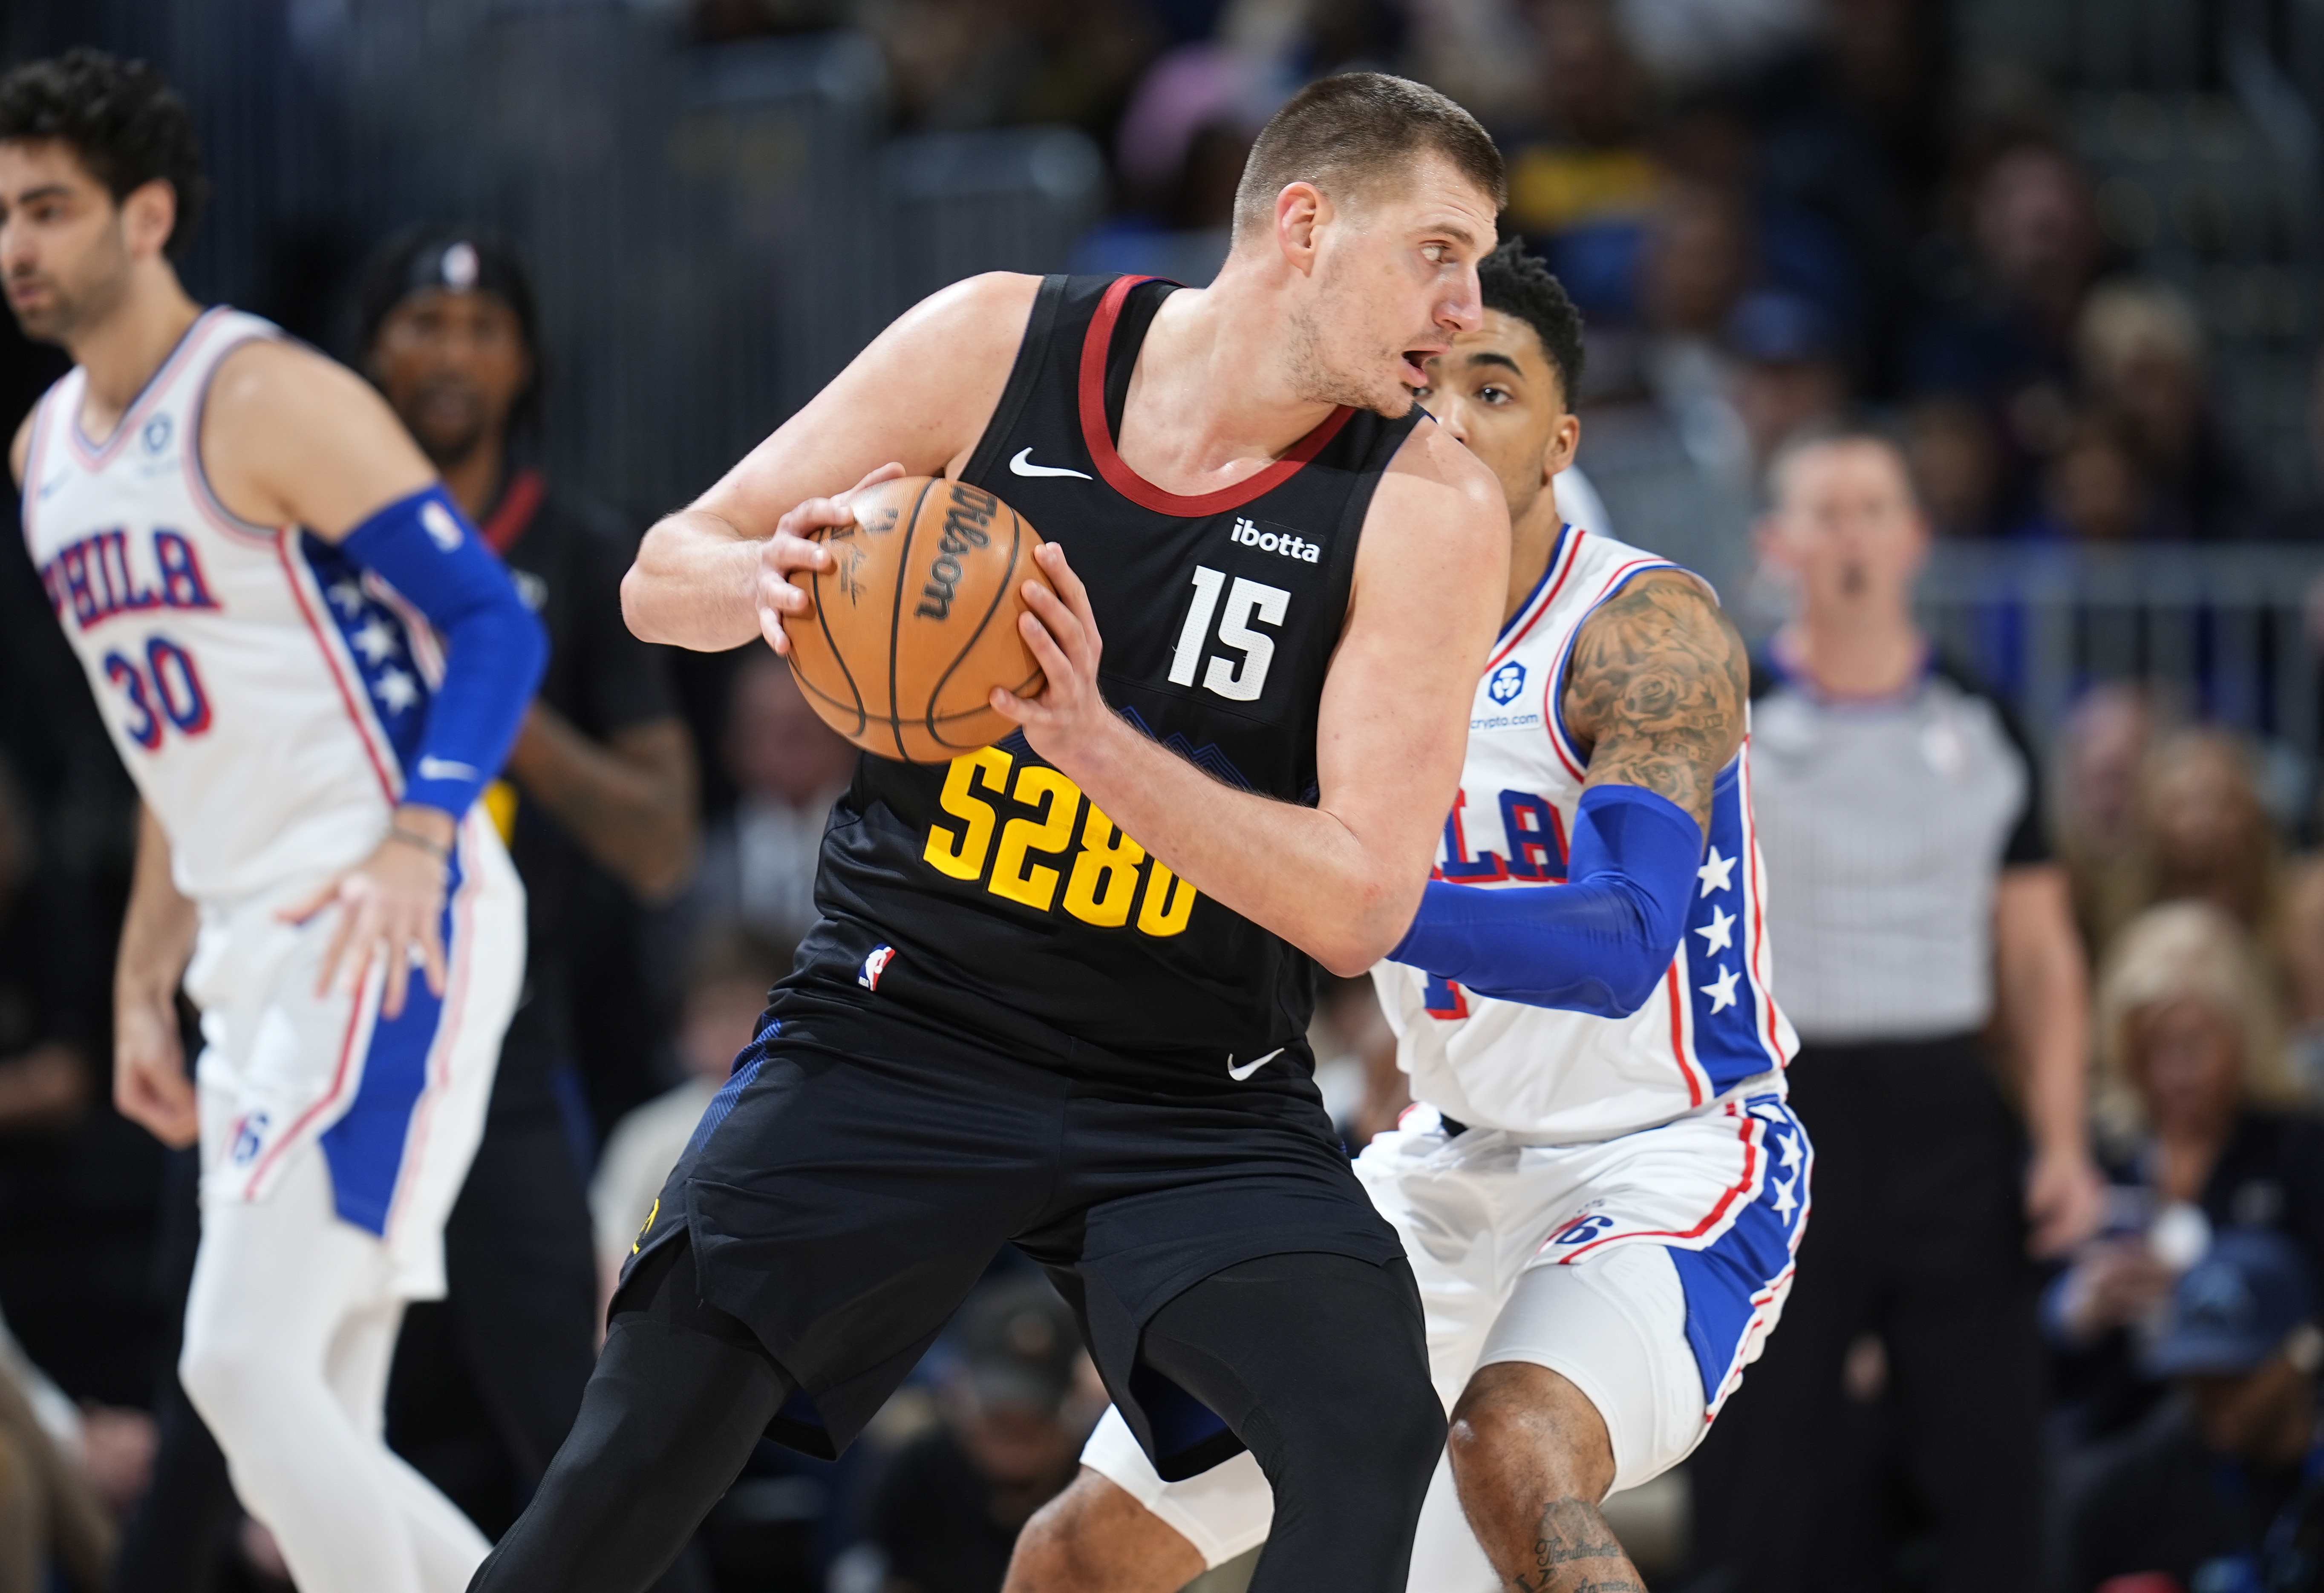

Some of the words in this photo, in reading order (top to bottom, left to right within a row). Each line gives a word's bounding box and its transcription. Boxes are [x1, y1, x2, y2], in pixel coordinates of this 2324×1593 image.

[913, 484, 997, 620] Wilson
[1231, 517, 1321, 563] ibotta
[104, 637, 213, 752] 30
[1168, 565, 1291, 701] 15
